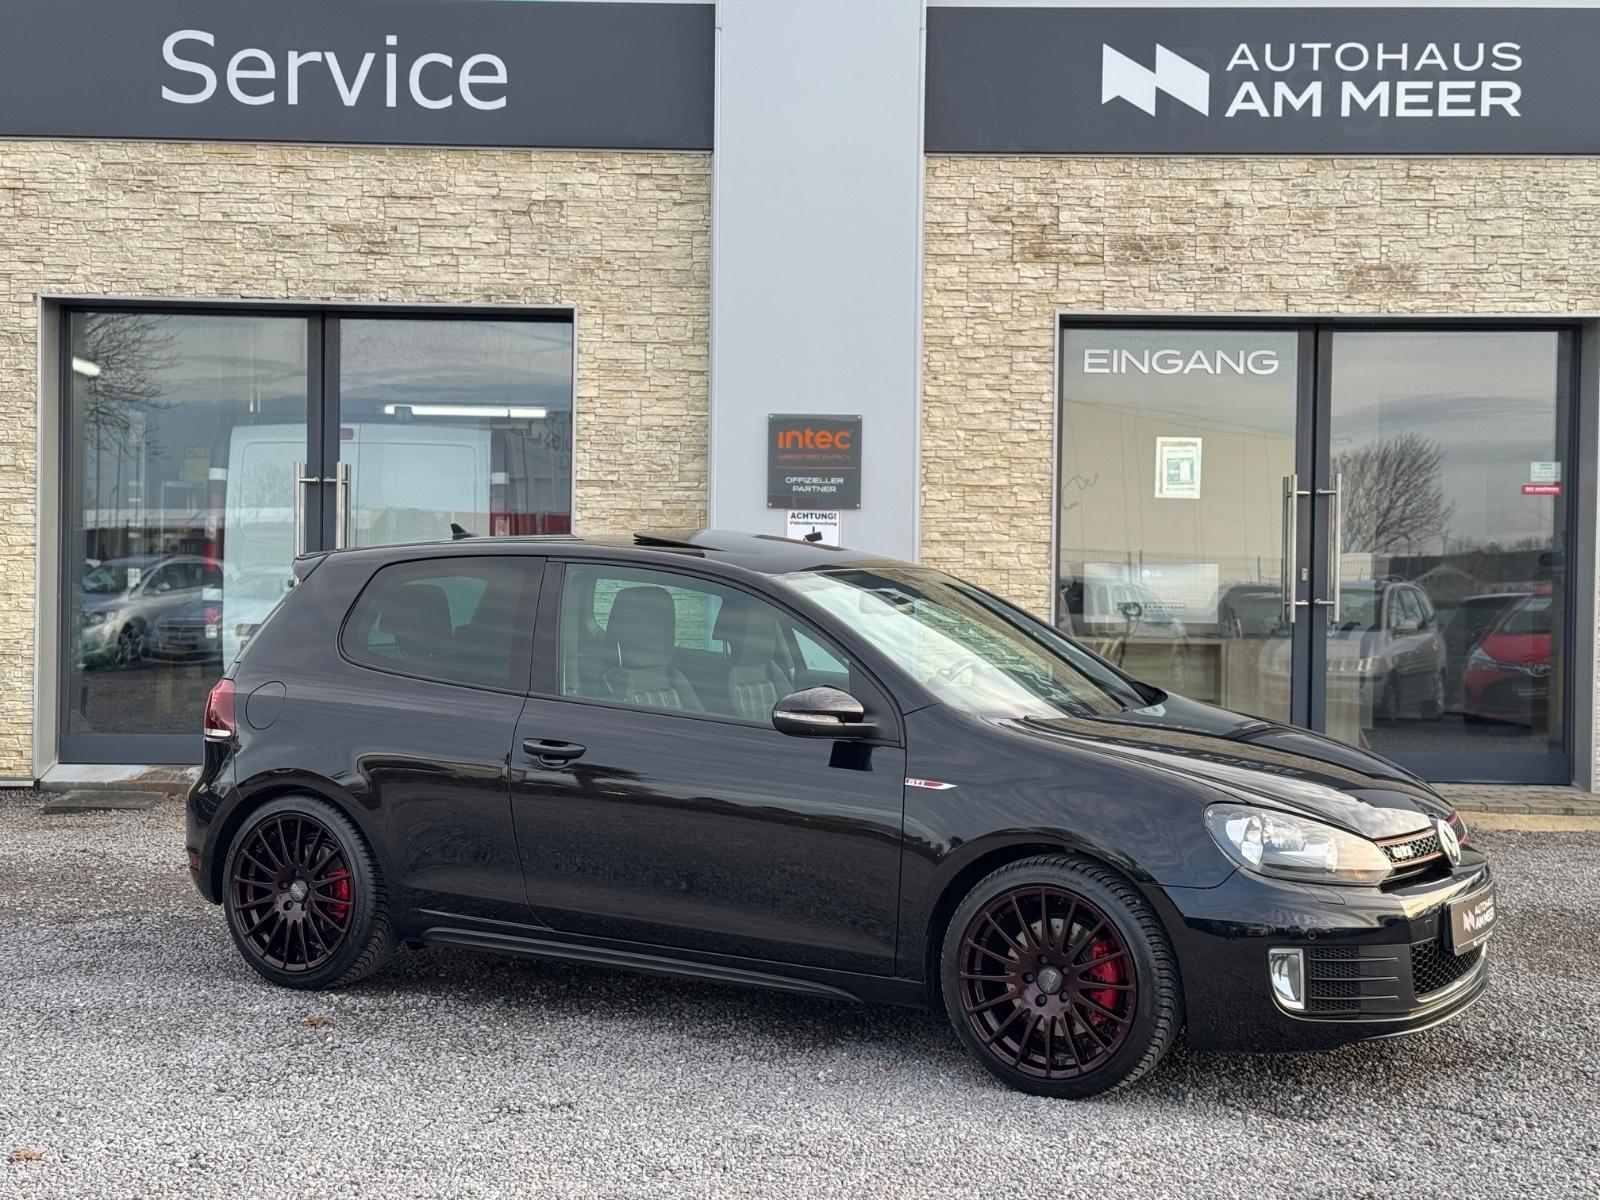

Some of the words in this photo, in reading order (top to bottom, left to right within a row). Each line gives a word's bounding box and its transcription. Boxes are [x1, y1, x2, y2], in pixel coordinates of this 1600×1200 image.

[162, 29, 508, 110] Service
[1226, 42, 1522, 71] AUTOHAUS
[1225, 81, 1322, 117] AM
[1341, 81, 1522, 117] MEER
[1083, 349, 1280, 375] EINGANG
[777, 428, 851, 449] intec
[790, 512, 837, 520] ACHTUNG!
